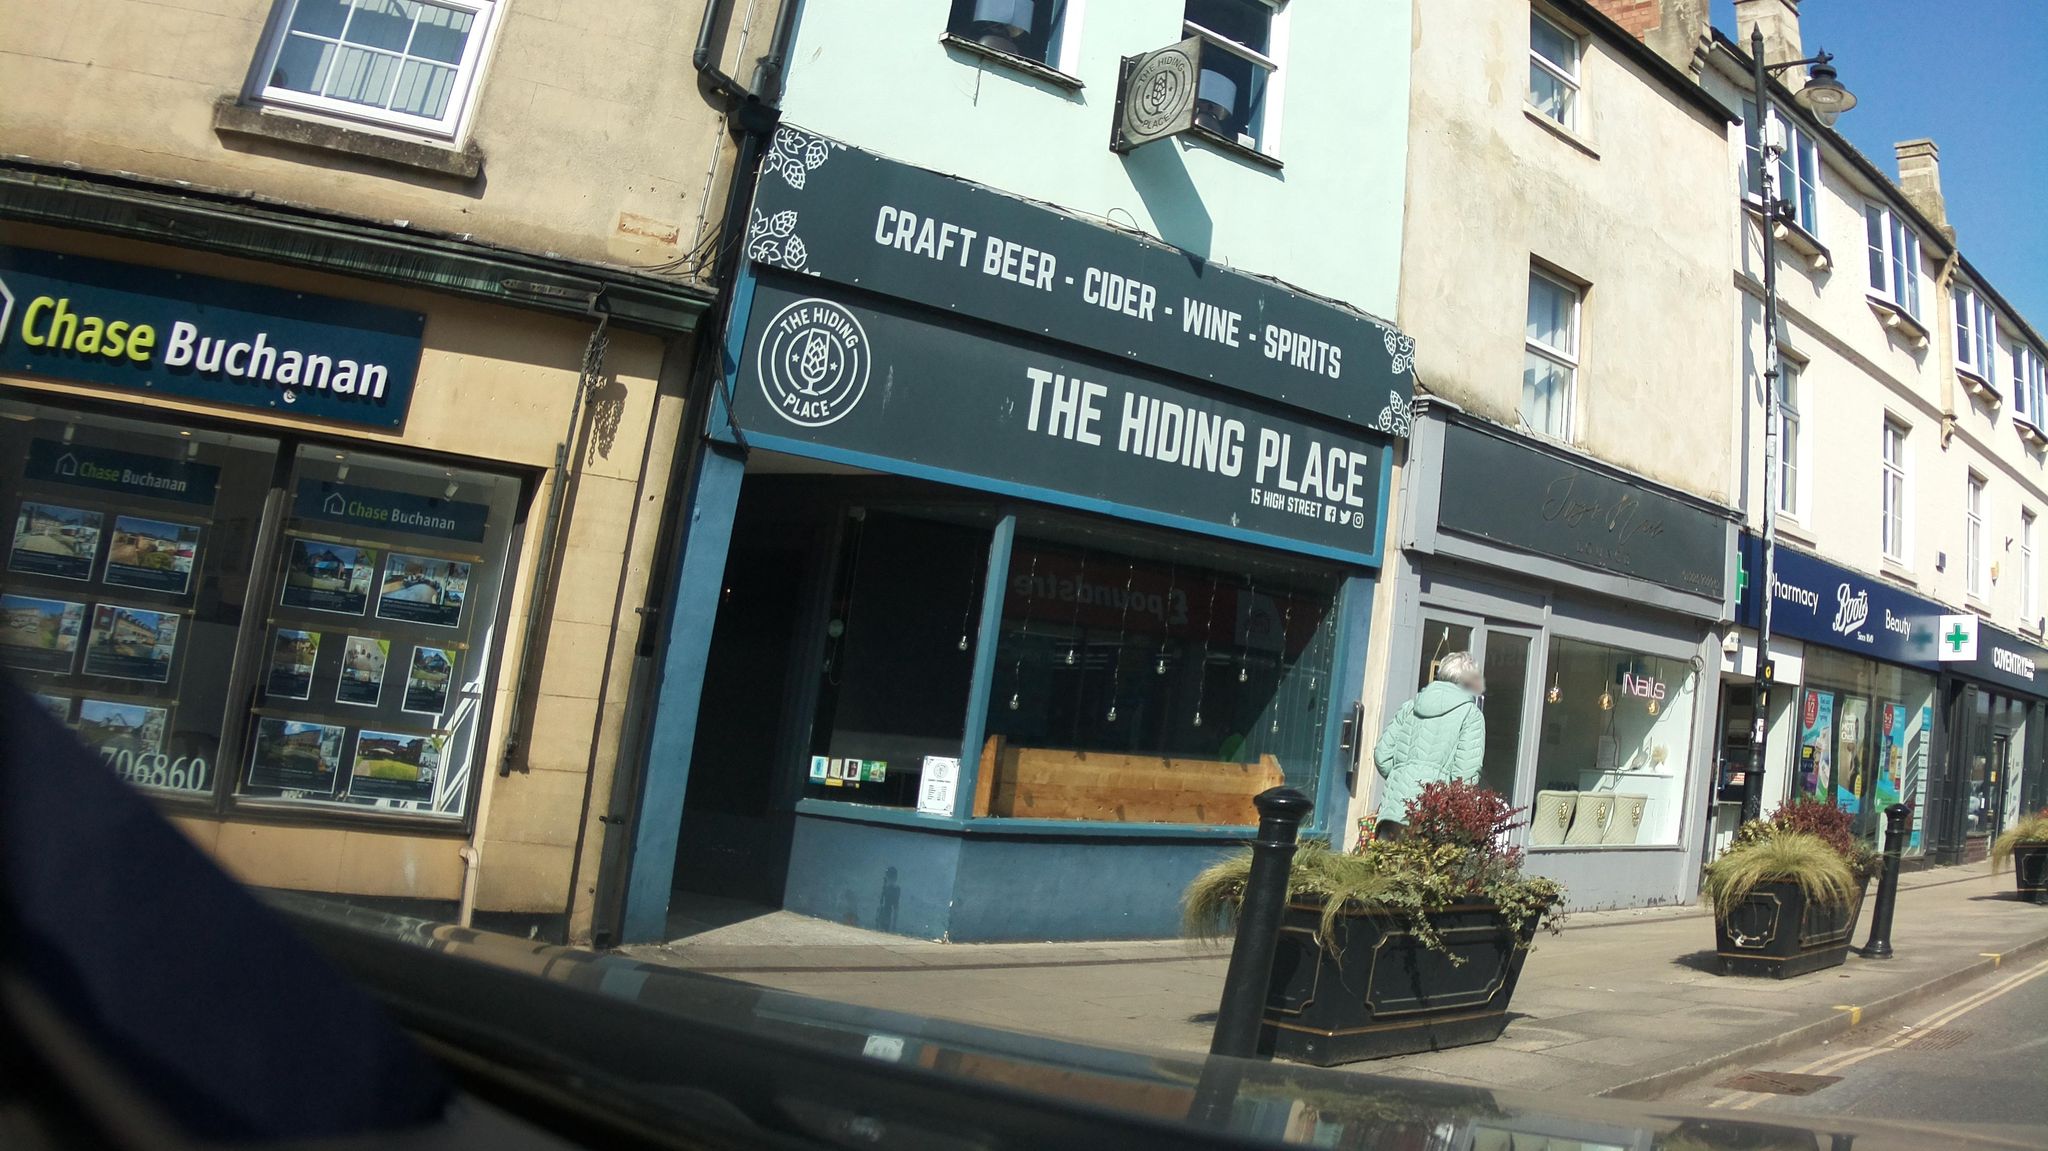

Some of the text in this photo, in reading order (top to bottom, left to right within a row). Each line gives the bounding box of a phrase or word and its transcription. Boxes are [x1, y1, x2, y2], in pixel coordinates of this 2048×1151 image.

[1140, 56, 1185, 130] THE HIDING PLACE
[874, 205, 976, 268] CRAFT
[983, 235, 1057, 292] BEER
[1084, 267, 1157, 322] CIDER
[1184, 296, 1240, 348] WINE
[1264, 324, 1342, 379] SPIRITS
[22, 296, 389, 399] Chase Buchanan
[780, 307, 859, 419] THE HIDING PLACE
[1026, 366, 1365, 509] THE HIDING PLACE
[79, 461, 187, 493] Chase Buchanan
[347, 500, 456, 531] Chase Buchanan
[1250, 487, 1322, 519] 15 HIGH STREET
[1832, 583, 1869, 637] Boots
[1885, 608, 1912, 642] Beauty
[1993, 646, 2027, 677] COVENTRY
[1622, 671, 1666, 701] Nails
[100, 745, 206, 792] 706860
